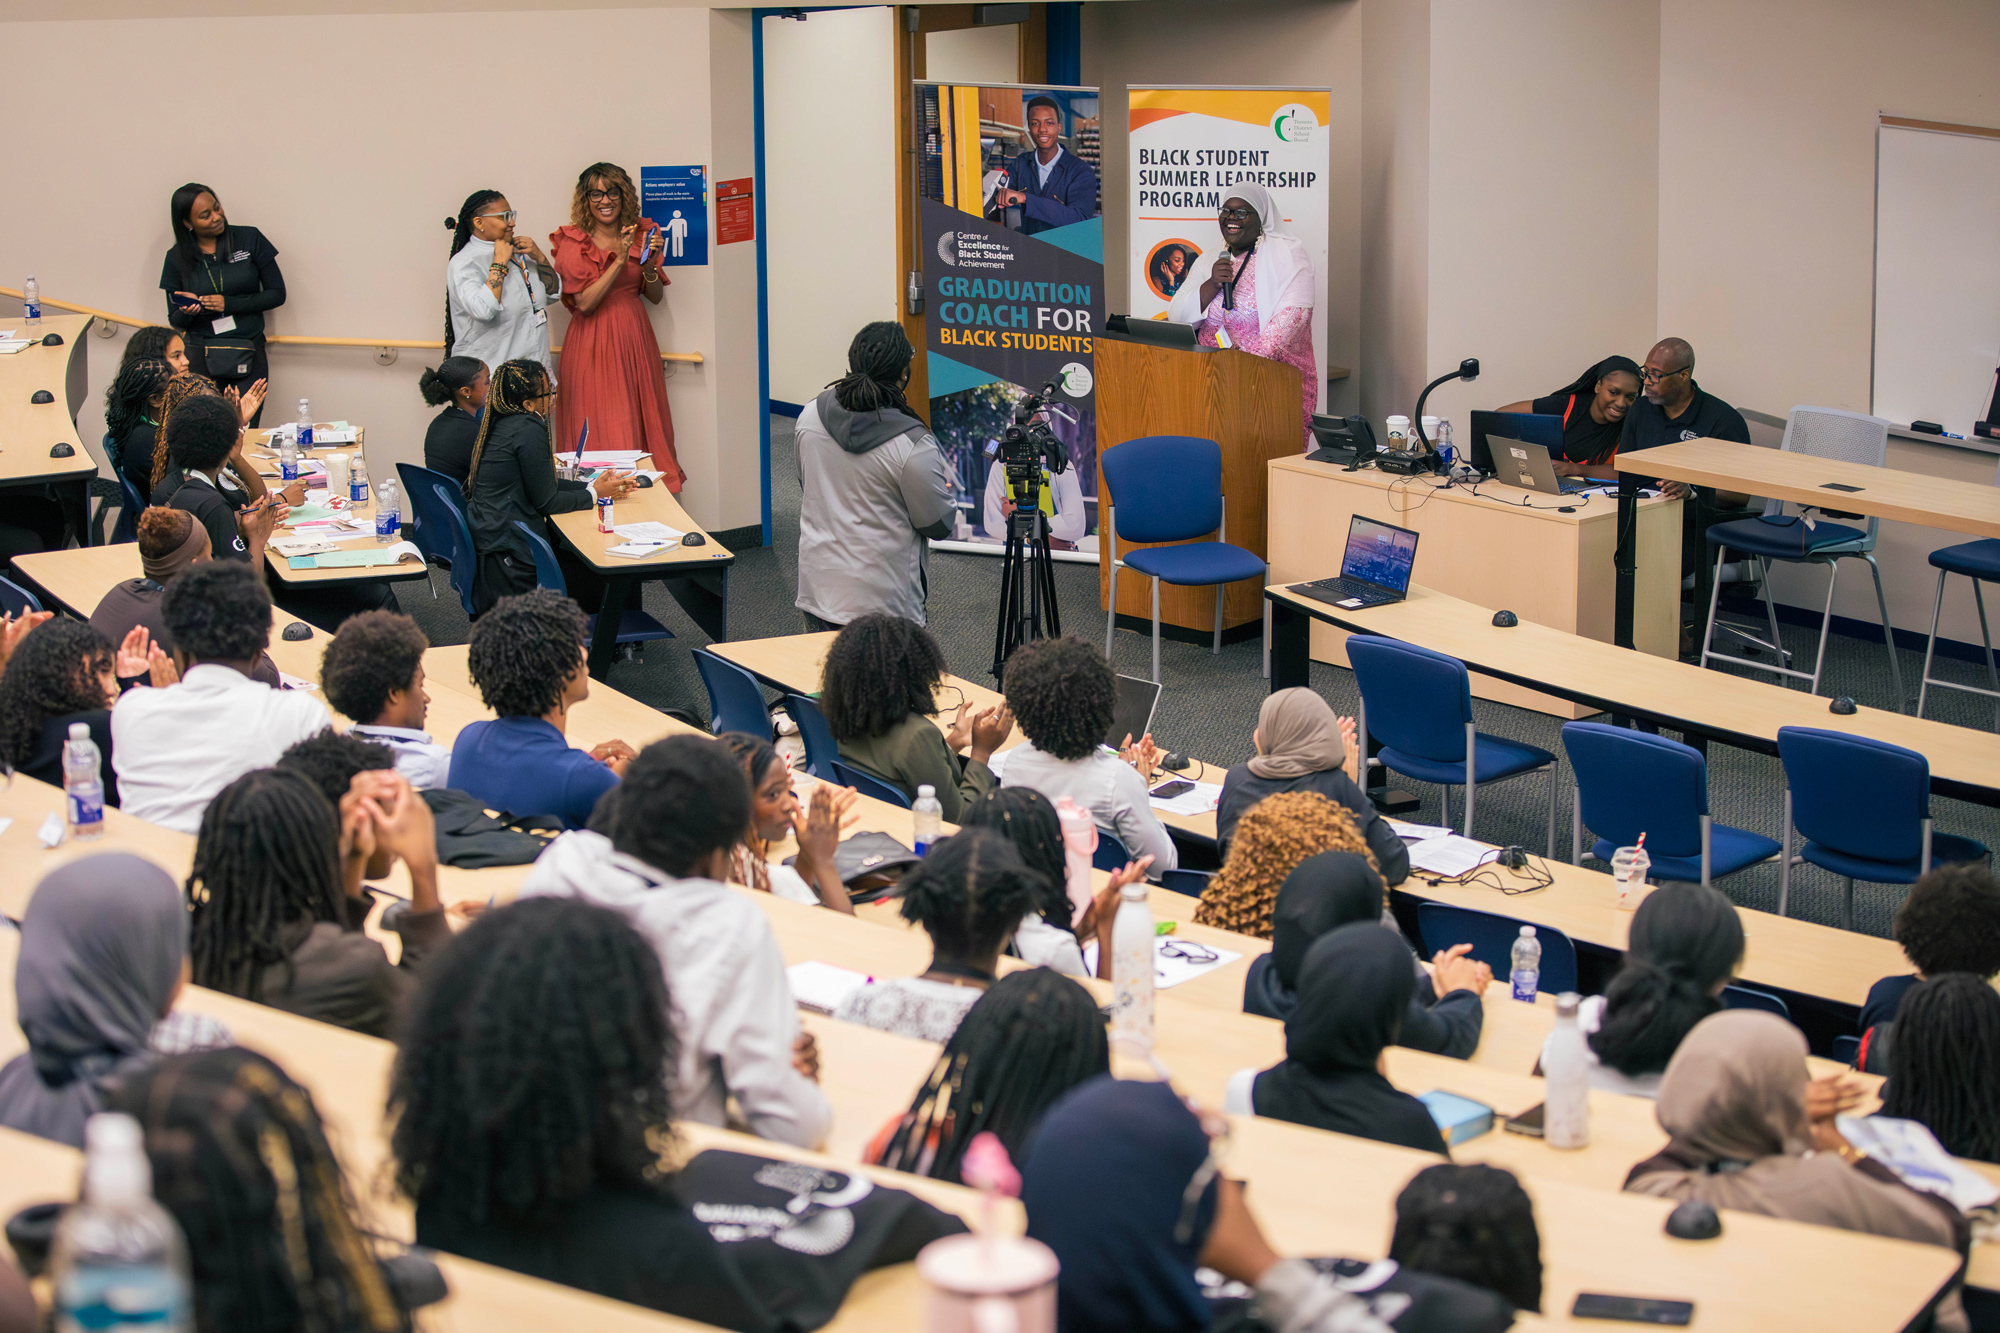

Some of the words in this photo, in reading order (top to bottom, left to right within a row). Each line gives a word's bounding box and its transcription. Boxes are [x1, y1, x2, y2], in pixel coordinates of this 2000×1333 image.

[1139, 149, 1190, 165] BLACK
[1196, 150, 1269, 166] STUDENT
[1139, 170, 1209, 186] SUMMER
[1217, 171, 1316, 188] LEADERSHIP
[1140, 191, 1220, 208] PROGRAM
[957, 232, 981, 240] Centre
[958, 241, 1000, 250] Excellence
[958, 250, 981, 258] Black
[984, 251, 1014, 260] Student
[958, 260, 1005, 269] Achievement
[938, 276, 1091, 306] GRADUATION
[939, 302, 1028, 328] COACH
[1037, 307, 1092, 332] FOR
[940, 328, 997, 347] BLACK
[1001, 332, 1093, 354] STUDENTS
